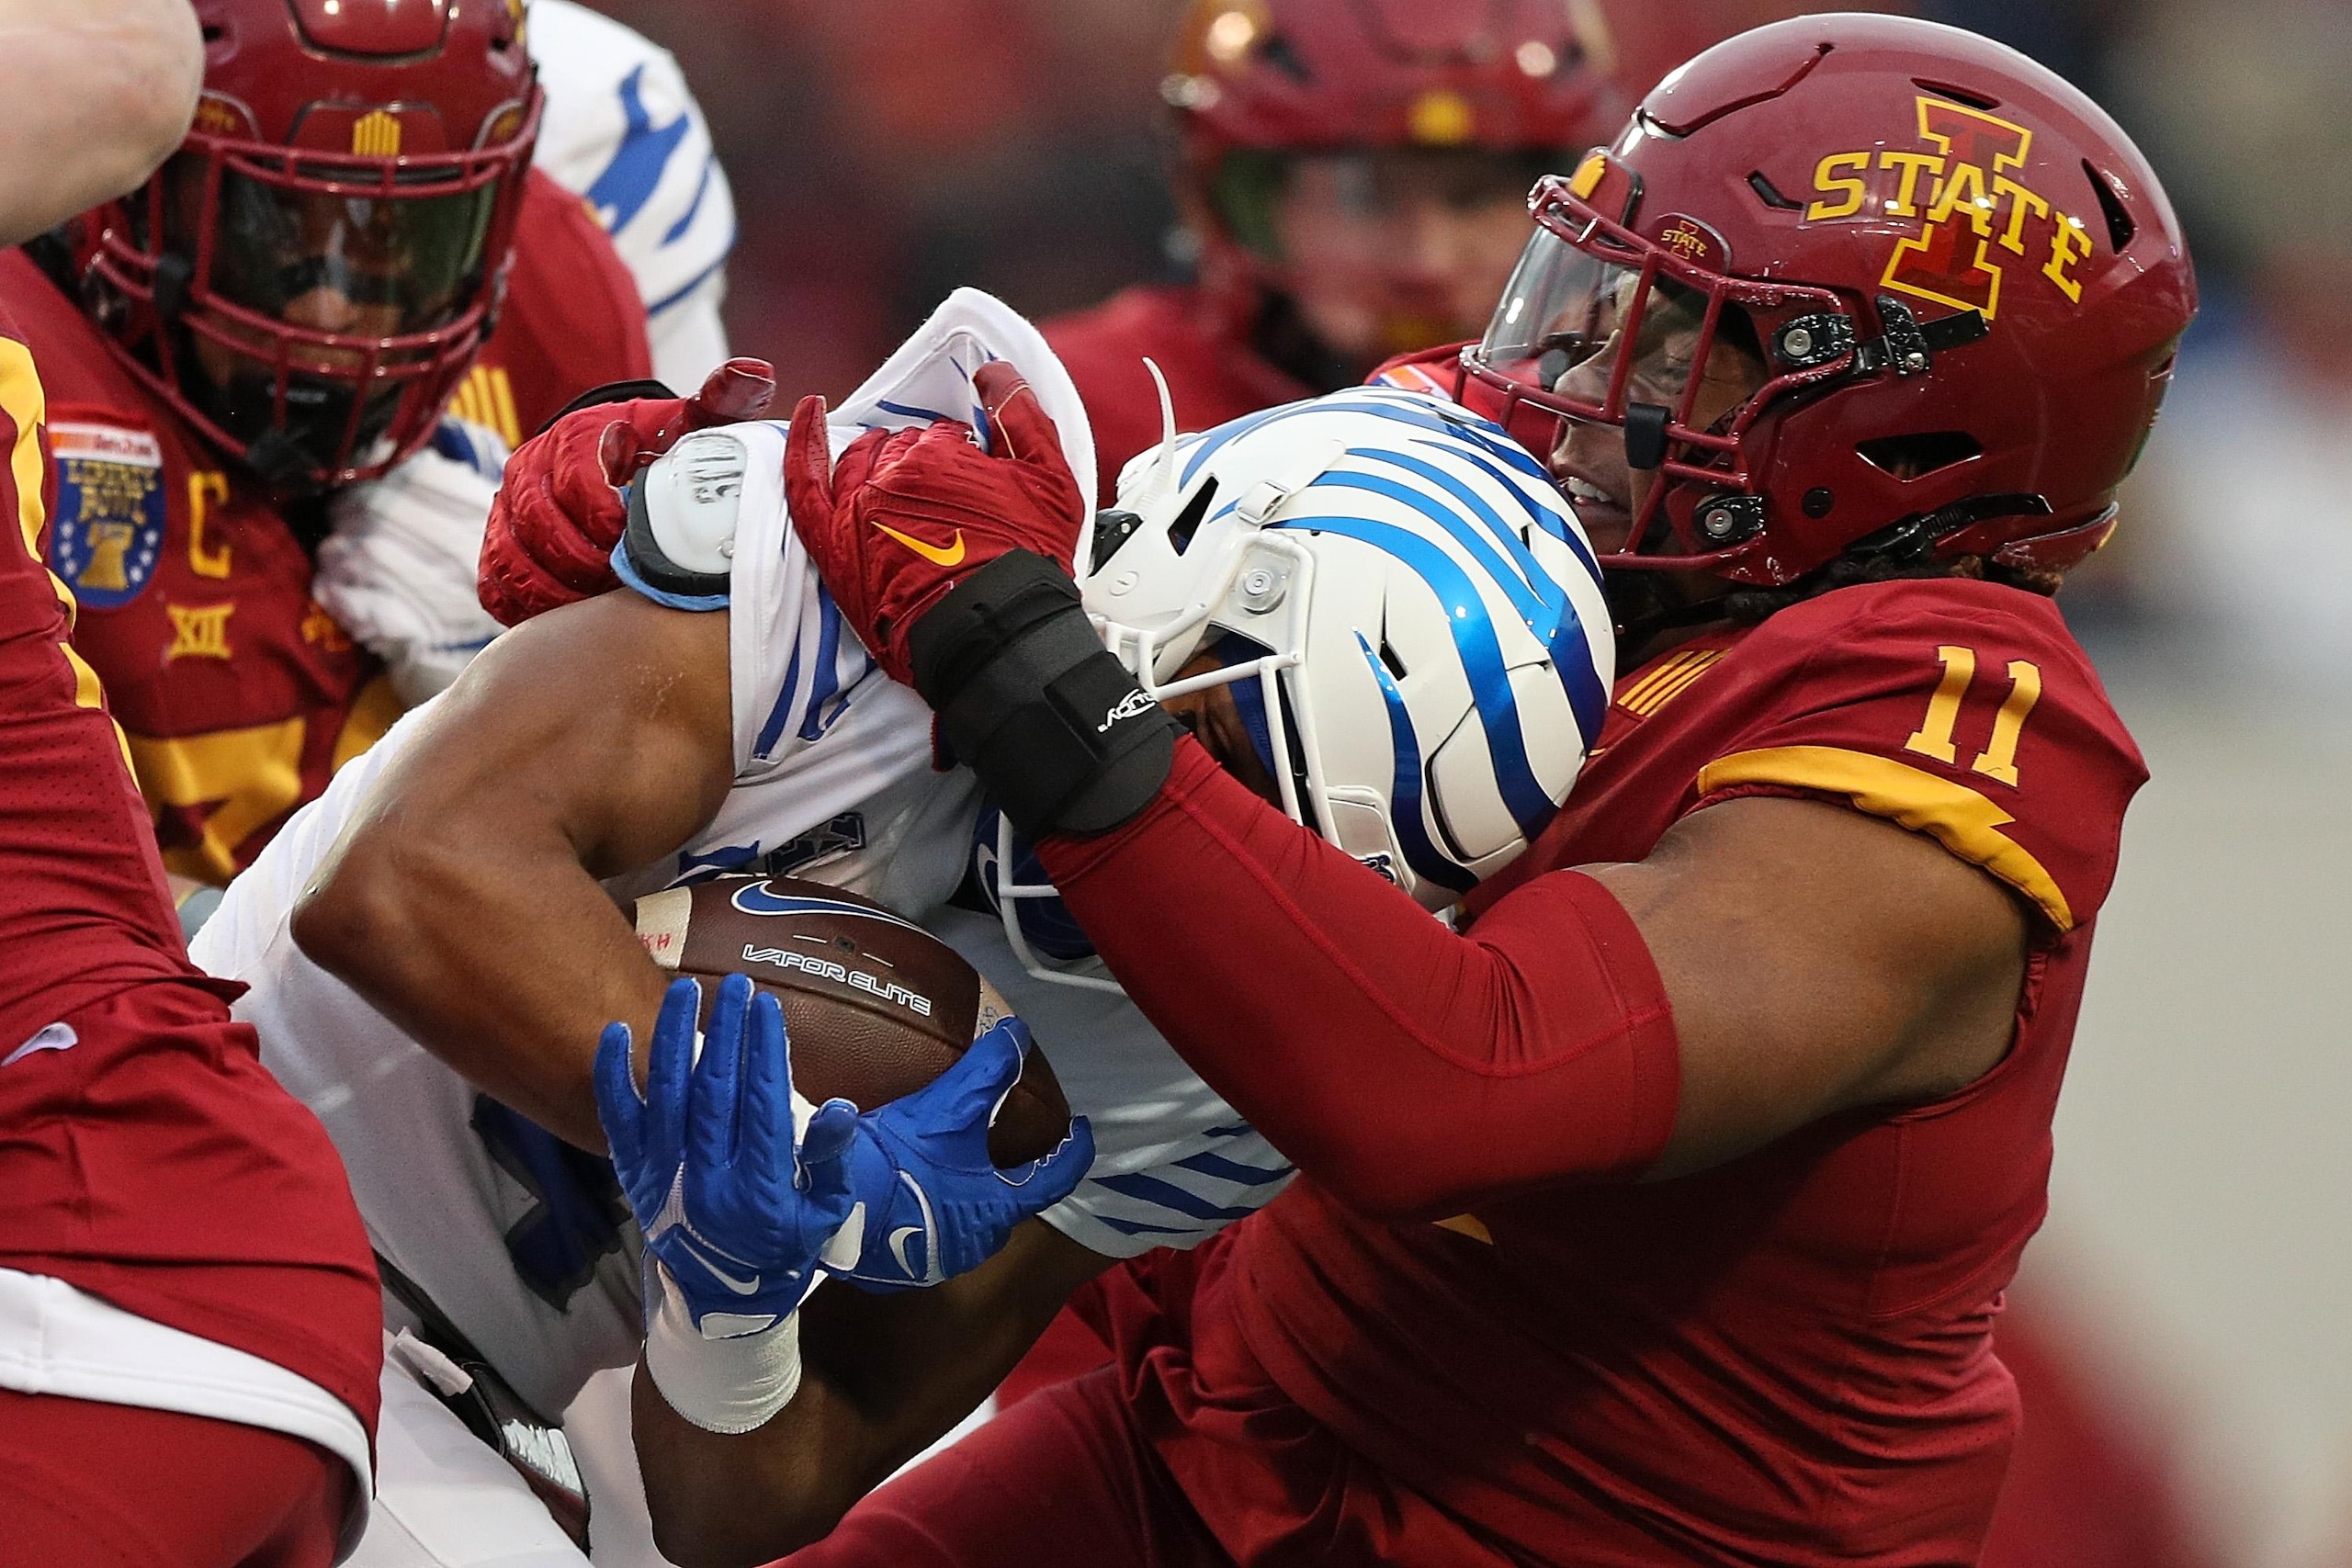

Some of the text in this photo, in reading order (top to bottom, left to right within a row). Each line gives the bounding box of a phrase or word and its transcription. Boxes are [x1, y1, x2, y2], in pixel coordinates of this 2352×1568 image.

[1660, 229, 1707, 257] STATE
[1806, 151, 2093, 303] STATE
[188, 470, 232, 579] C
[165, 603, 236, 660] XII
[1904, 645, 2041, 787] 11
[742, 943, 932, 1017] VAPOR ELITE
